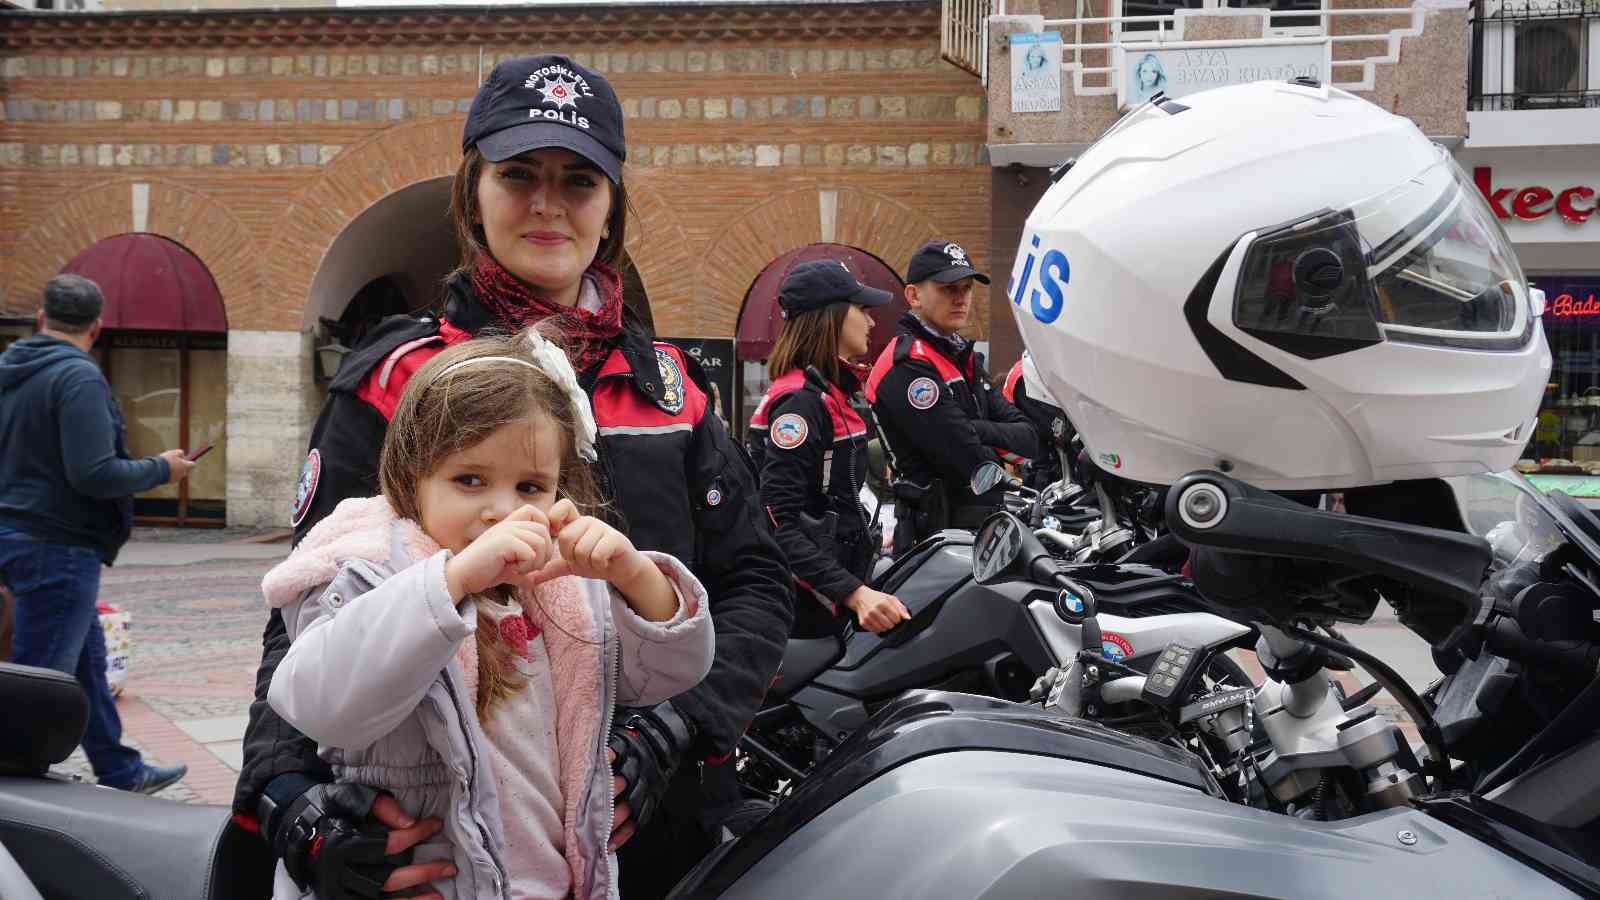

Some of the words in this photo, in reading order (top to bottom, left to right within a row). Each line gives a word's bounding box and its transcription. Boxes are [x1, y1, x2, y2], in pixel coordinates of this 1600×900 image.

[525, 65, 594, 97] MOTOSİKLETLİ
[529, 108, 590, 129] POLİS
[1473, 166, 1600, 225] keç
